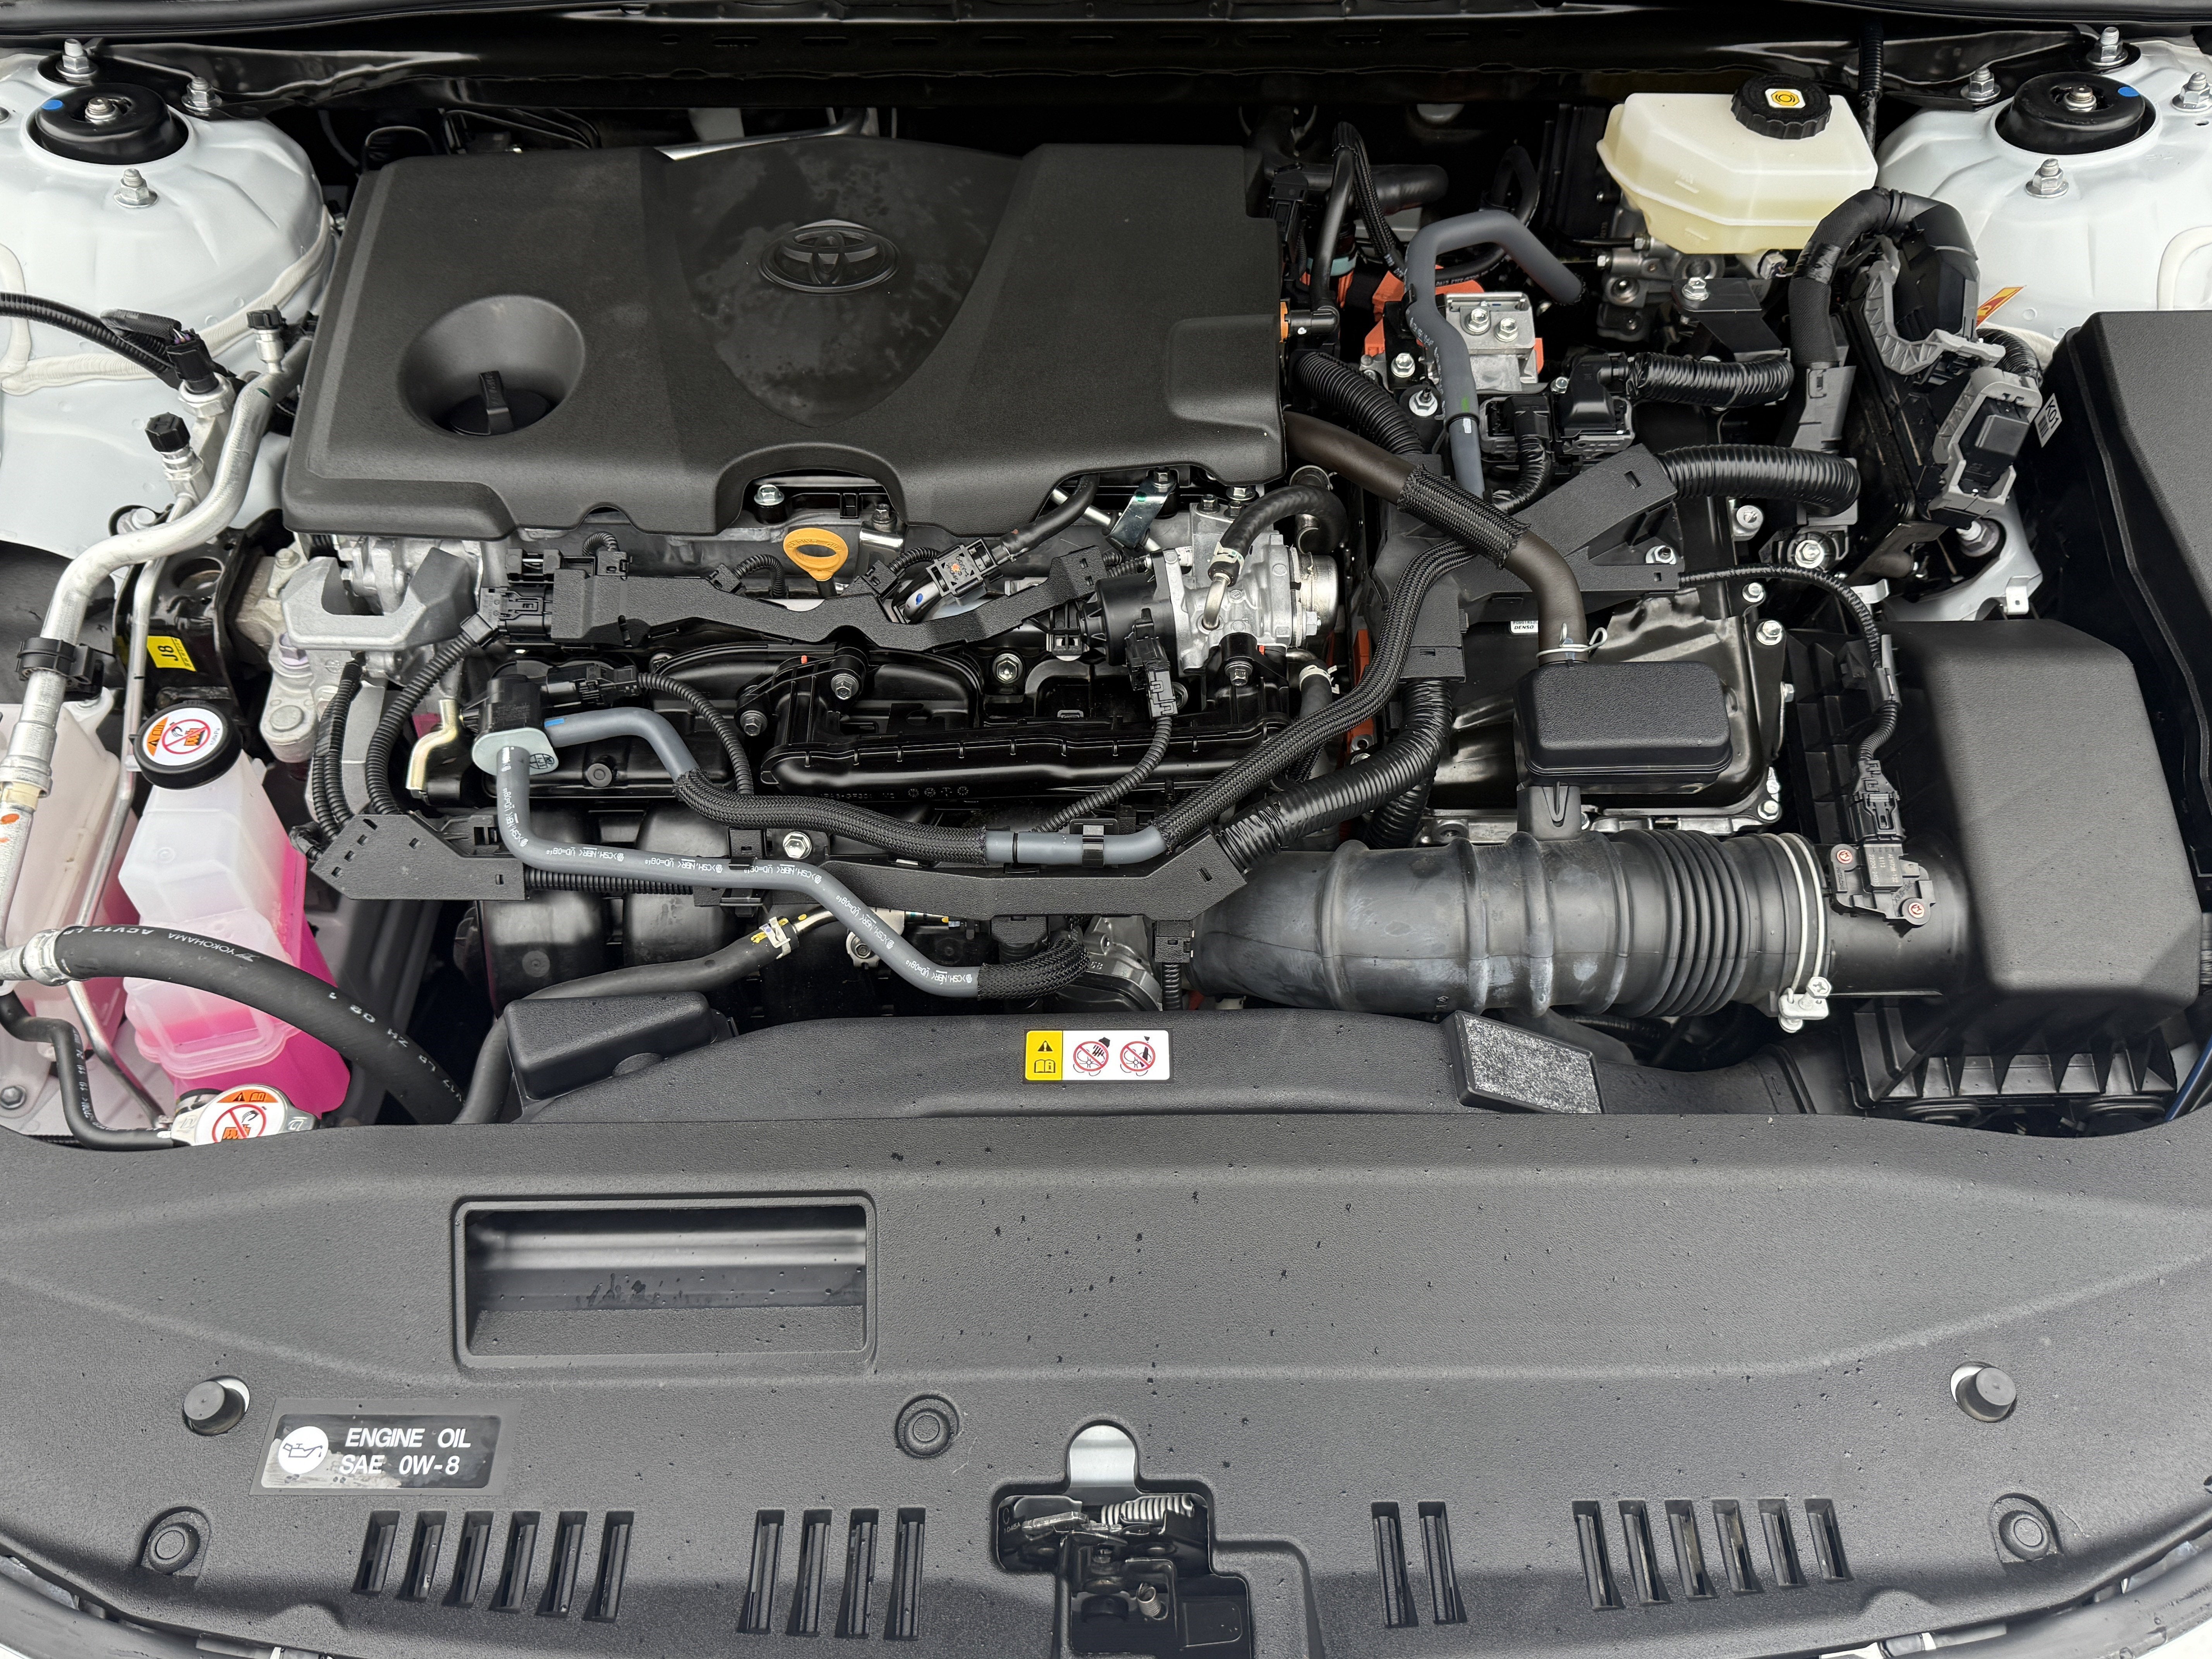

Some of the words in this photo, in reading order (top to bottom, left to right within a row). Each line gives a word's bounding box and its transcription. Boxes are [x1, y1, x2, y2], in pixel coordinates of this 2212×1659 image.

[2045, 399, 2059, 429] K01
[92, 926, 154, 935] ACV17
[167, 932, 235, 955] YOKOHAMA
[345, 1428, 423, 1447] ENGINE
[438, 1428, 471, 1448] OIL
[339, 1455, 384, 1475] SAE
[399, 1455, 460, 1475] 0W-8
